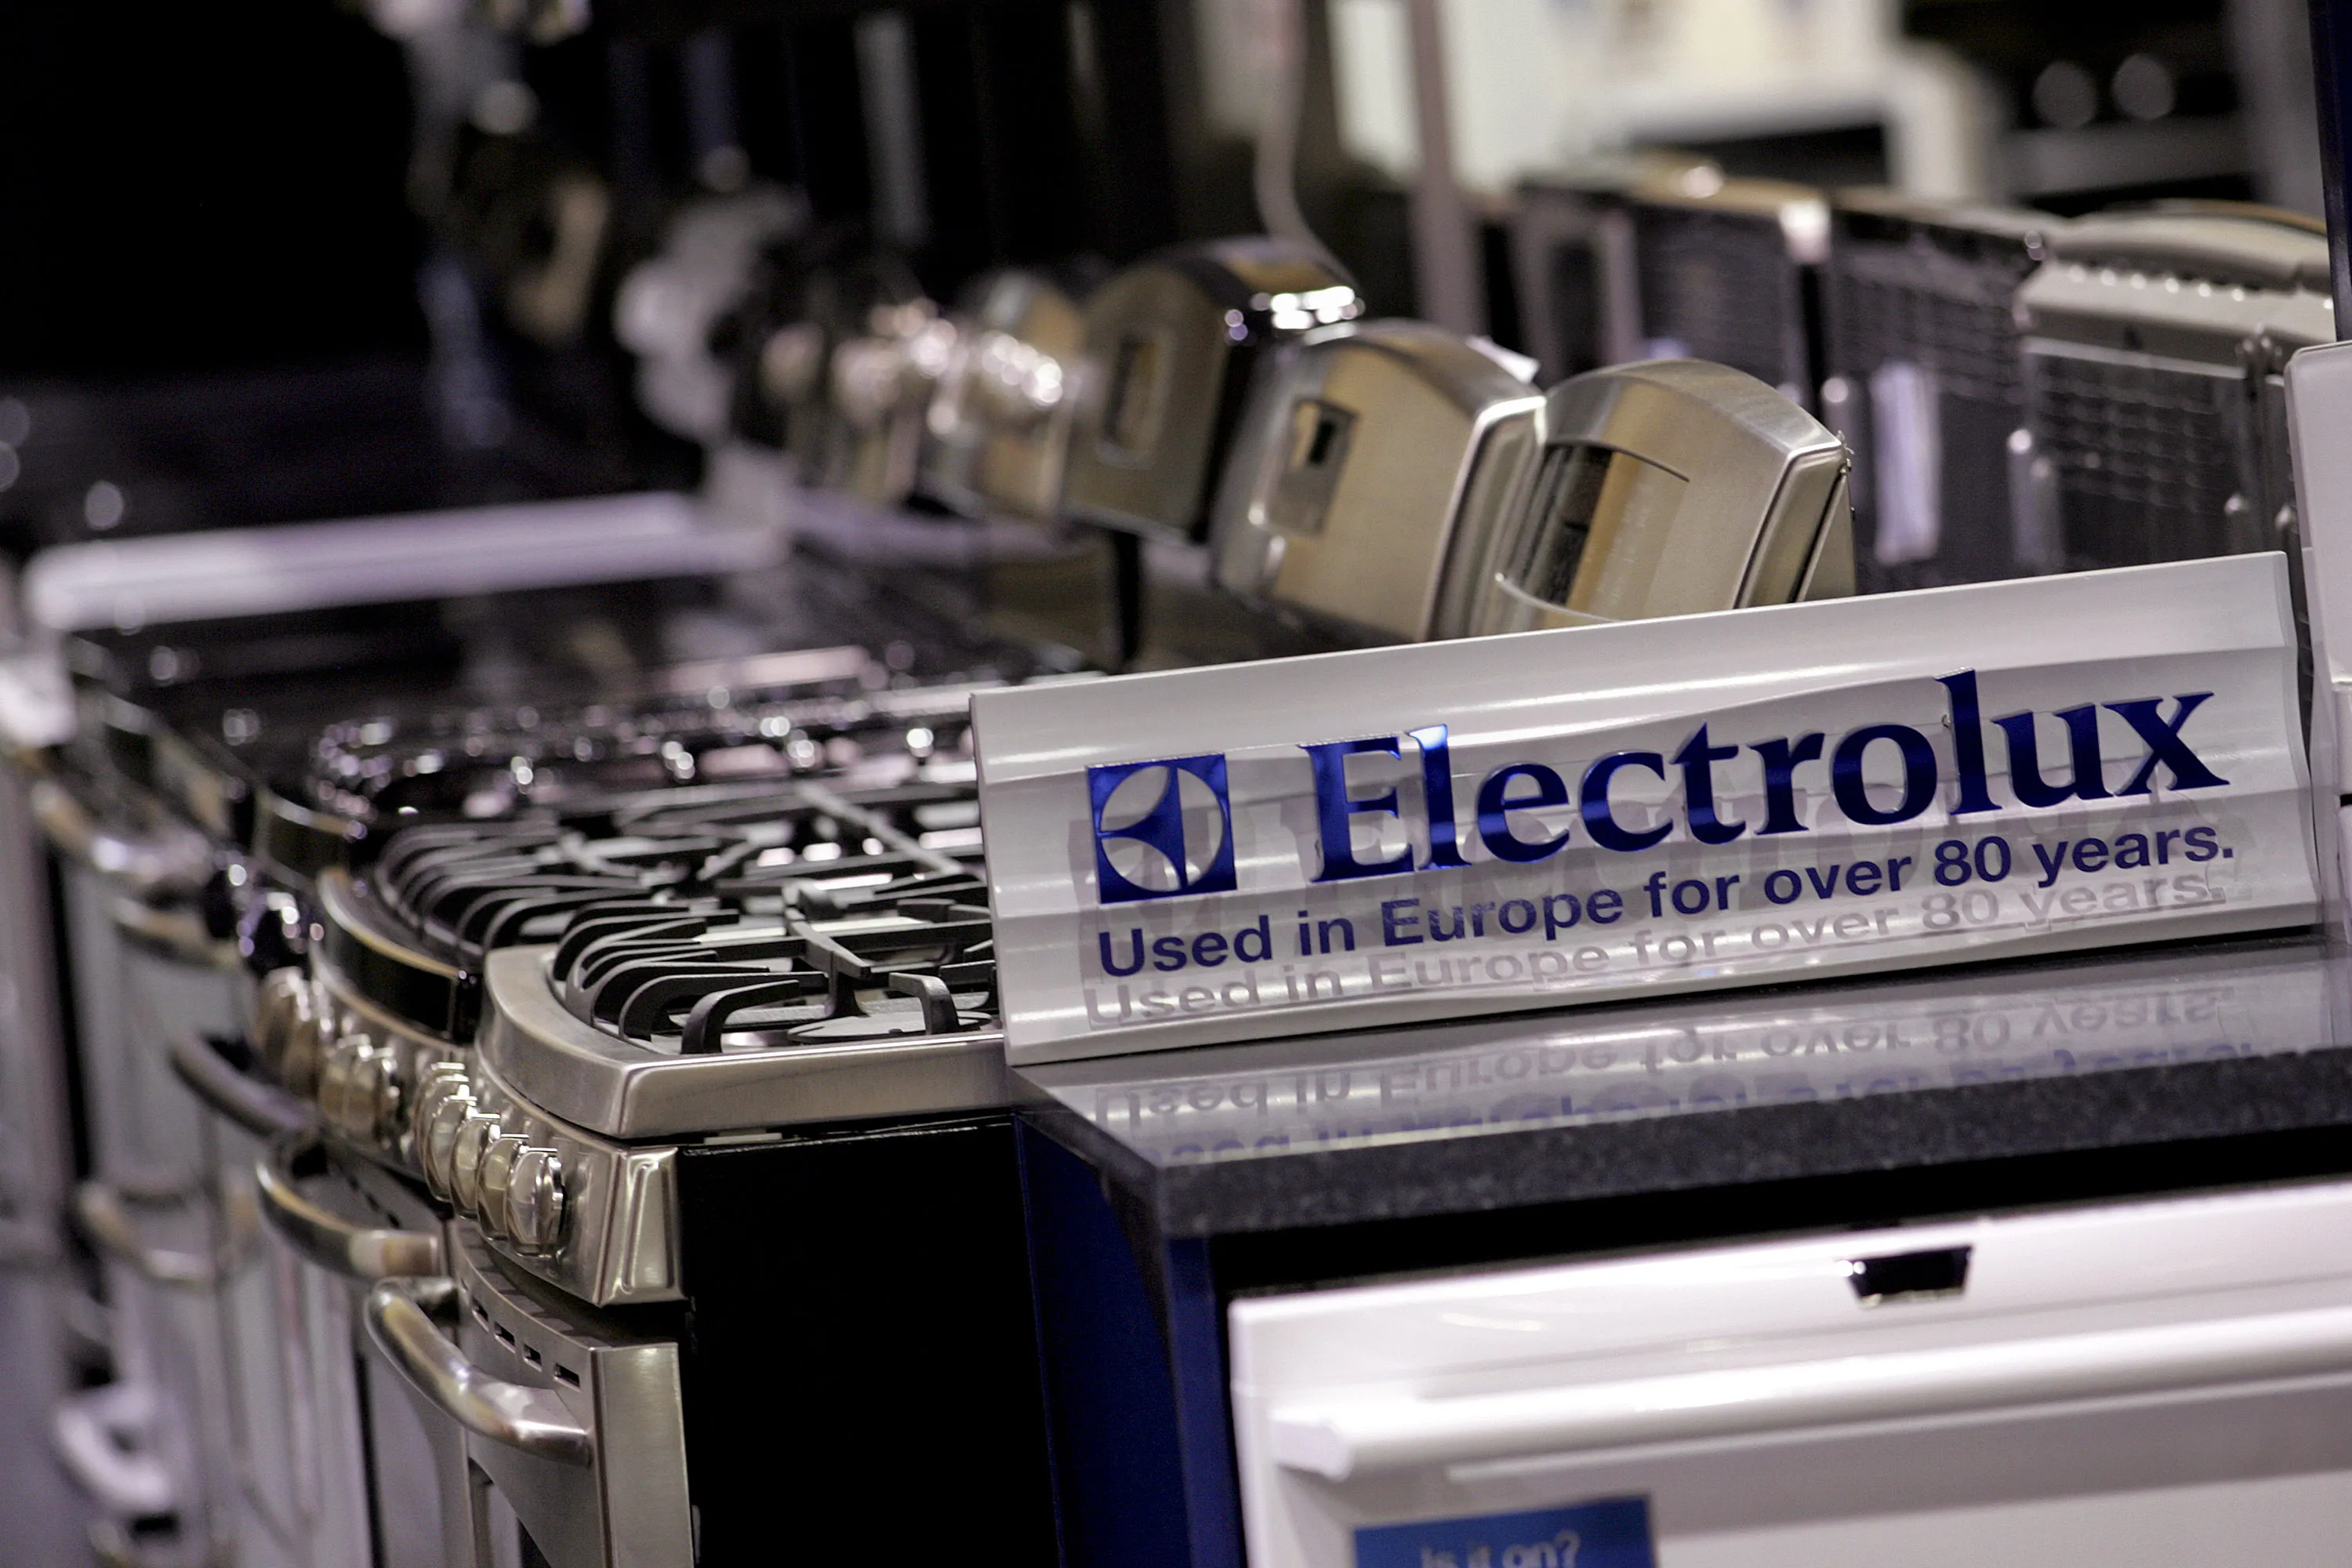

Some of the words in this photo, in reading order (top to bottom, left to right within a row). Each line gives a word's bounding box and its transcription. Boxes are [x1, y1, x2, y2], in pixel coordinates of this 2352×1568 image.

[1298, 670, 2230, 884] Electrolux
[1099, 913, 1272, 977] Used
[1298, 910, 1355, 956] in
[1381, 887, 1624, 947] Europe
[1643, 870, 1740, 918] for
[1764, 855, 1912, 906] over
[1934, 835, 2012, 887] 80
[2032, 826, 2236, 888] years.
